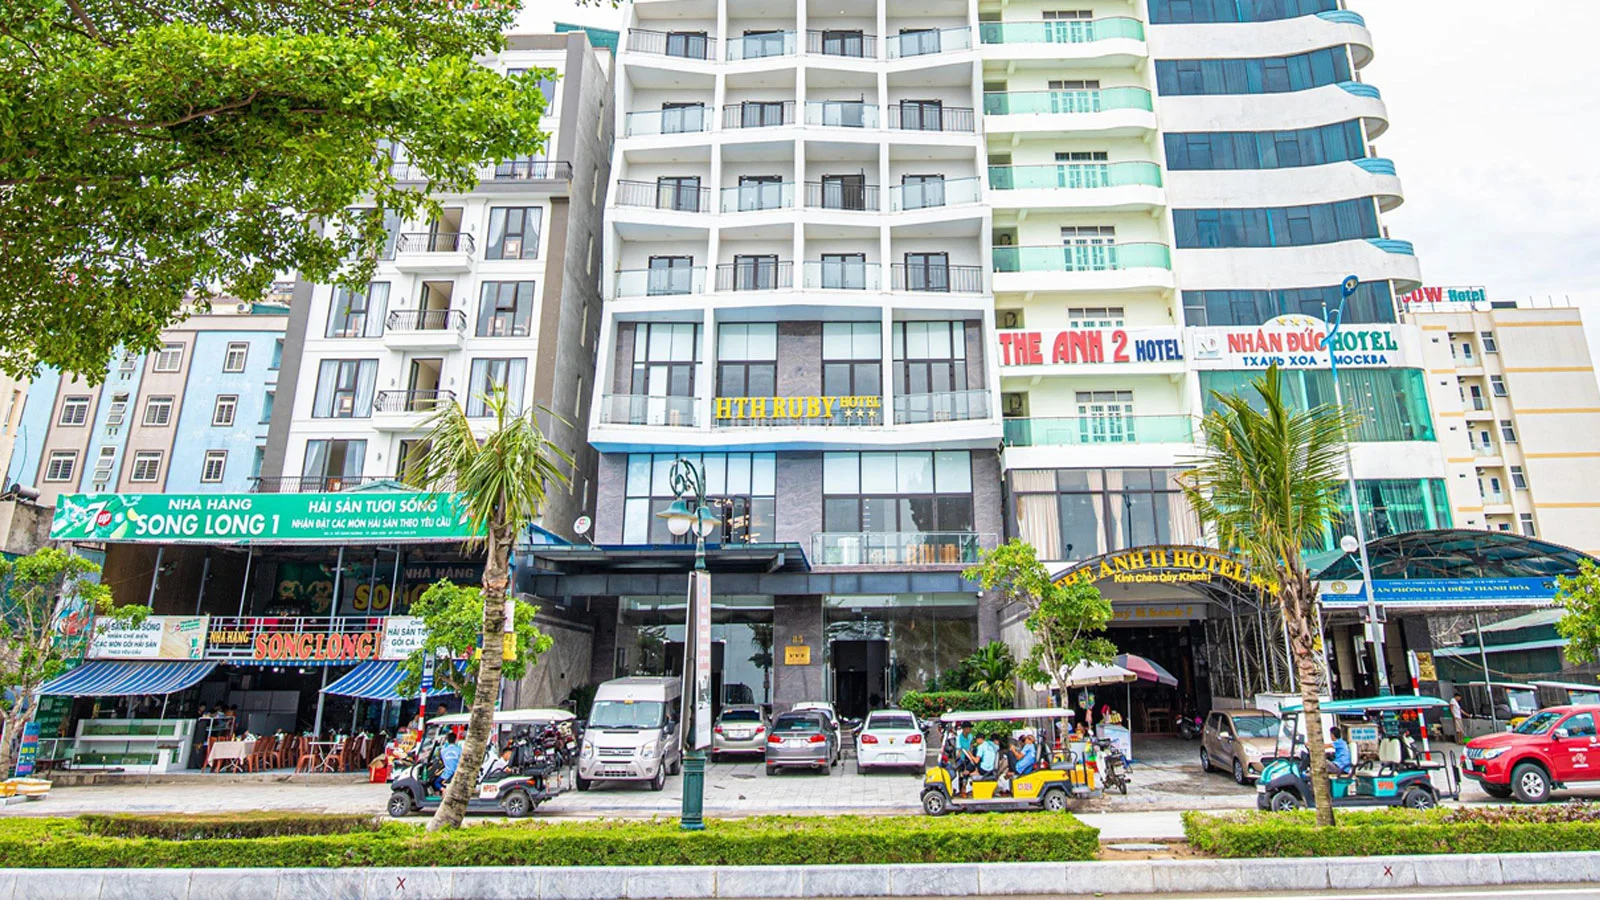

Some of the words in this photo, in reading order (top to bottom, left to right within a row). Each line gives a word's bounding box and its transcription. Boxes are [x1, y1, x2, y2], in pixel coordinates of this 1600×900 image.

[1448, 289, 1485, 301] Hotel
[1287, 327, 1328, 352] ĐỨC
[1332, 331, 1398, 351] HOTEL
[999, 332, 1043, 366] THE
[1052, 330, 1104, 364] ANH
[1112, 330, 1130, 363] 2
[1135, 339, 1183, 362] HOTEL
[715, 397, 766, 419] HTH
[772, 396, 836, 418] RUBY
[840, 396, 881, 408] HOTEL
[168, 496, 201, 510] NHÀ
[207, 496, 252, 510] HÀNG
[308, 497, 332, 513] HẢI
[335, 497, 362, 513] SẢN
[366, 499, 396, 513] TƯƠI
[399, 496, 437, 513] SỐNG
[135, 514, 198, 535] SONG
[204, 514, 265, 535] LONG
[272, 514, 280, 534] 1
[331, 517, 346, 529] CÁC
[368, 516, 380, 528] HẢI
[382, 516, 399, 528] SẢN
[400, 518, 419, 528] THEO
[421, 515, 434, 527] YÊU
[435, 566, 475, 579] HÀNG
[1100, 551, 1147, 580] ANH
[1150, 551, 1167, 568] II
[1173, 550, 1248, 583] HOTEL
[1135, 571, 1158, 583] Chào
[210, 627, 227, 643] NHÀ
[228, 627, 250, 643] HÀNG
